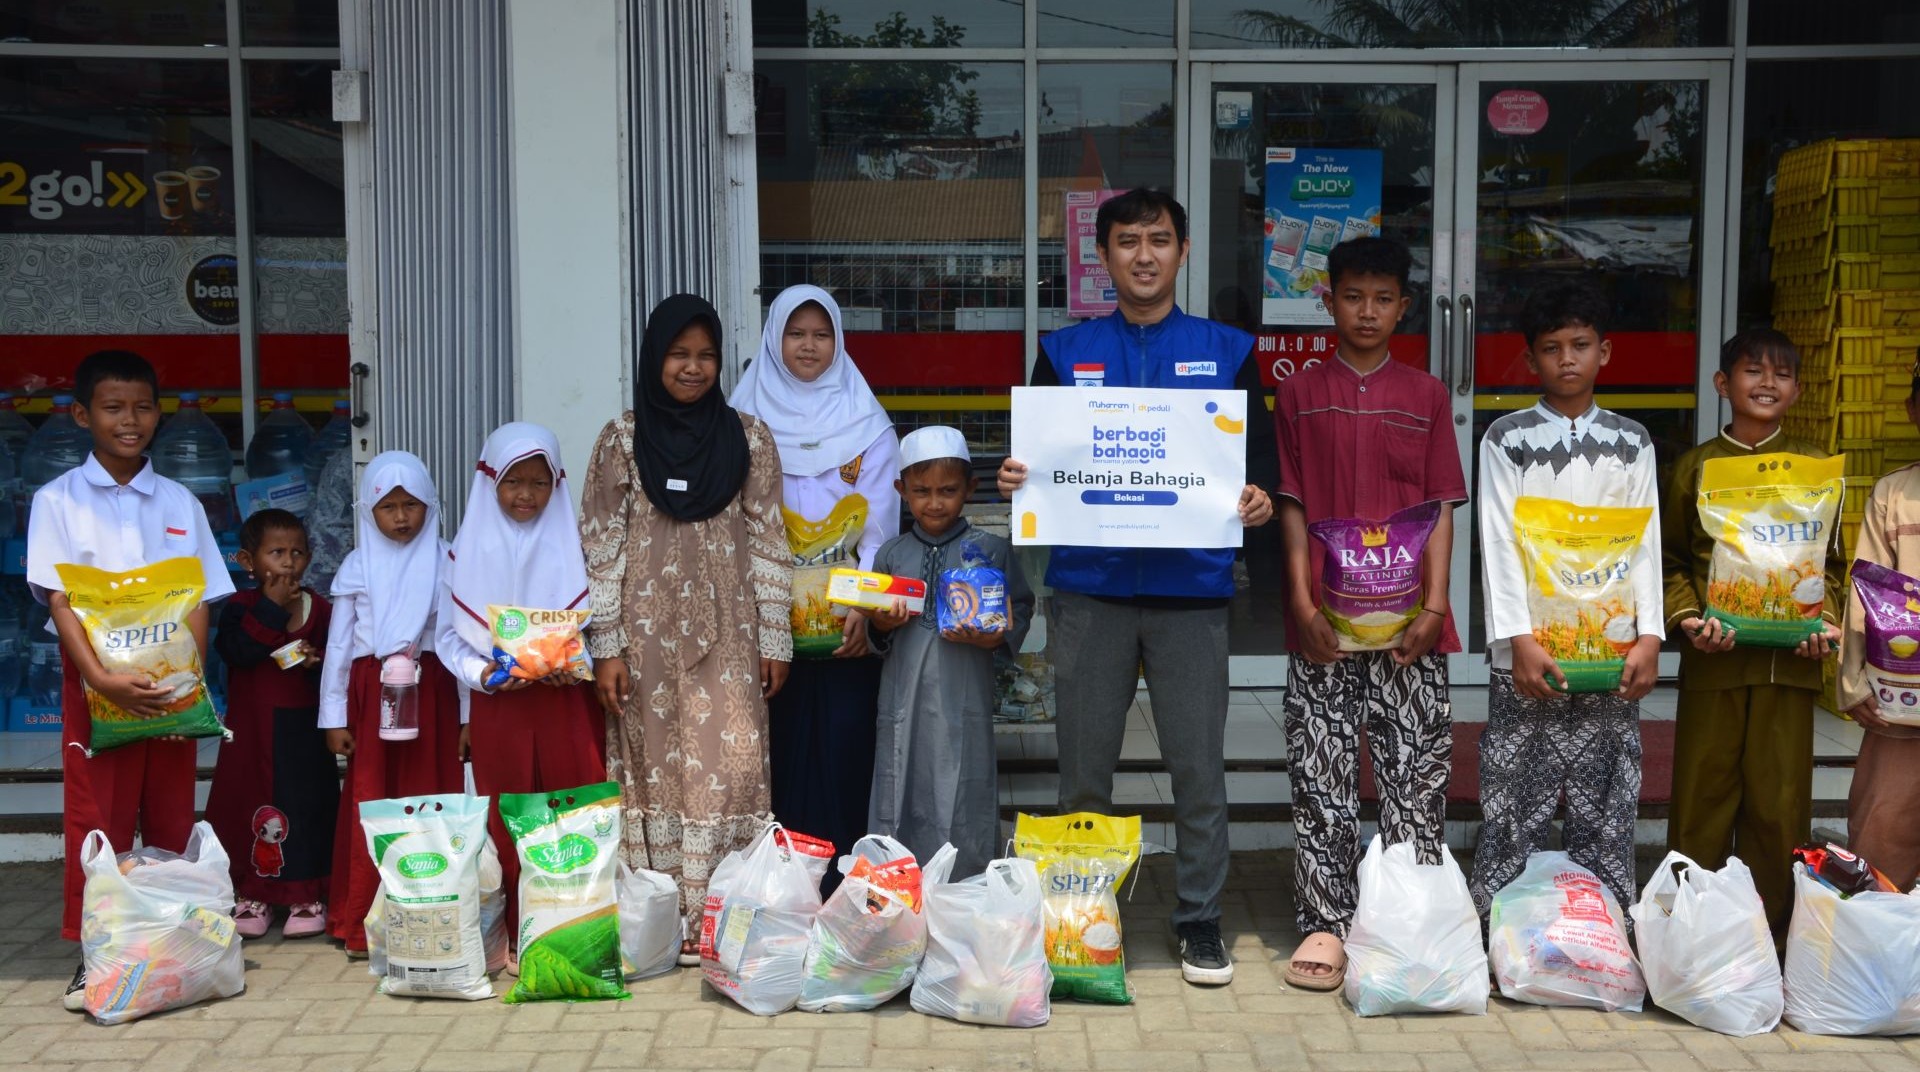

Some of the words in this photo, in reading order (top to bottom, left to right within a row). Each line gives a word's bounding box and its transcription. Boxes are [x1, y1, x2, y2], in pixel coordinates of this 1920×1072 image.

[1302, 164, 1321, 173] The
[1324, 164, 1348, 173] New
[1298, 179, 1350, 193] DJOY
[1178, 363, 1214, 374] dtpeduli
[1089, 400, 1129, 409] Muharram
[1093, 425, 1165, 445] berbagi
[1093, 443, 1165, 463] bahagia
[1053, 470, 1122, 487] Belanja
[1130, 471, 1205, 488] Bahagia
[1114, 493, 1145, 502] Bekasi
[1752, 520, 1823, 543] SPHP
[1339, 545, 1414, 569] RAJA
[1343, 570, 1413, 581] PLATINUM
[1561, 560, 1630, 586] SPHP
[1343, 583, 1369, 593] Beras
[1371, 581, 1413, 593] Premium
[105, 621, 178, 649] SPHP
[539, 841, 584, 863] Sania
[405, 857, 439, 873] Sania
[1051, 874, 1116, 895] SPHP
[1563, 929, 1585, 938] Lewat
[1587, 932, 1611, 944] Alfagift
[1562, 937, 1588, 946] Official
[1590, 941, 1618, 953] Alfamart
